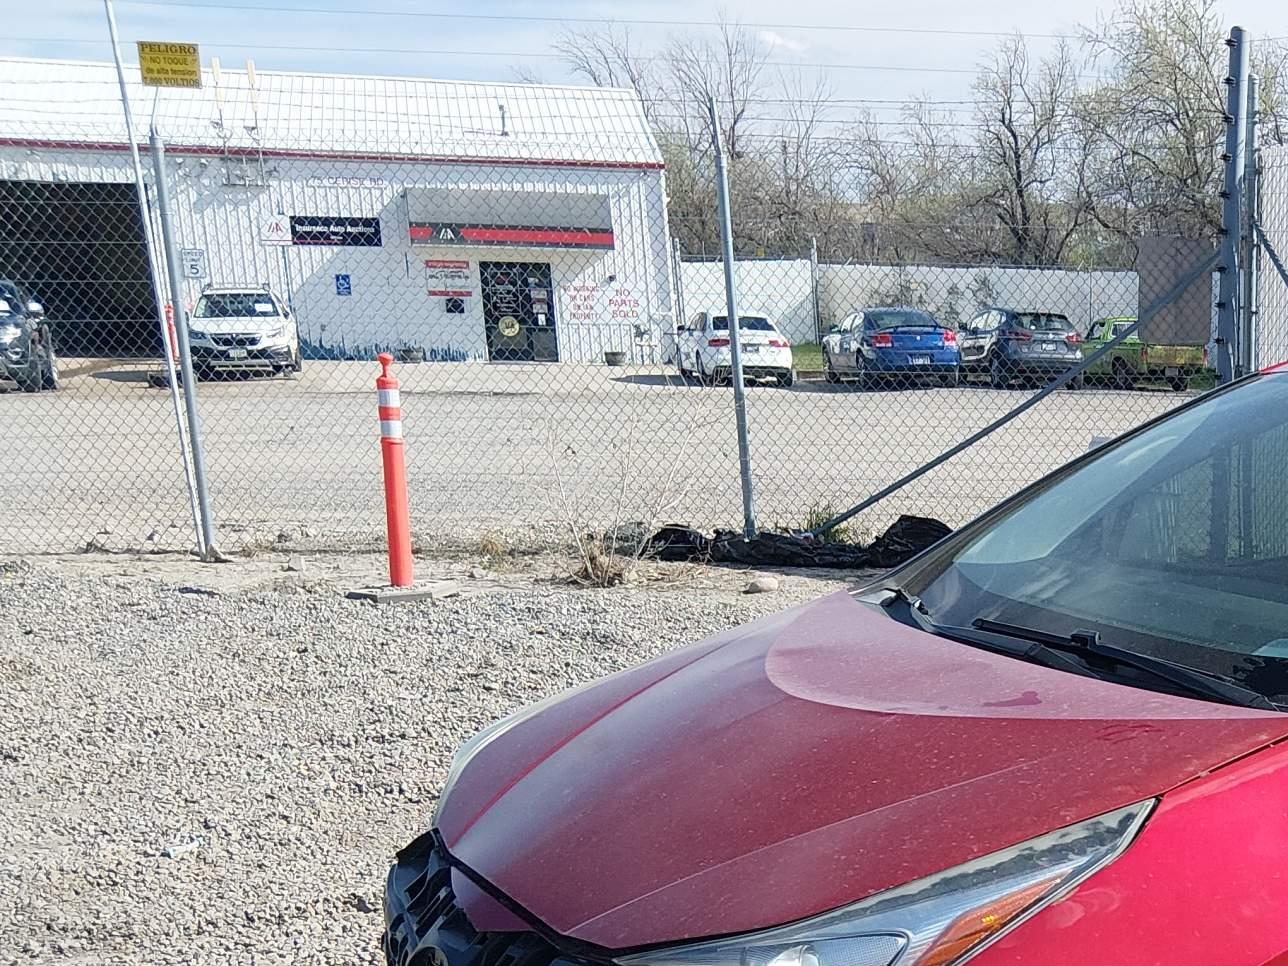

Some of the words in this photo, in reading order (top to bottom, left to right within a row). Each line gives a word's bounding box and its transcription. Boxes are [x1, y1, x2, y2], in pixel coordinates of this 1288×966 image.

[141, 43, 197, 55] PELIGRO
[150, 56, 160, 65] NO
[162, 57, 189, 66] TOQUE
[163, 77, 200, 88] VOLTIOS
[295, 223, 328, 232] Insurance
[329, 224, 346, 233] Auto
[346, 224, 375, 233] Auctions
[190, 264, 200, 275] 5
[615, 288, 631, 297] NO
[608, 299, 640, 308] PARTS
[612, 309, 639, 319] SOLD
